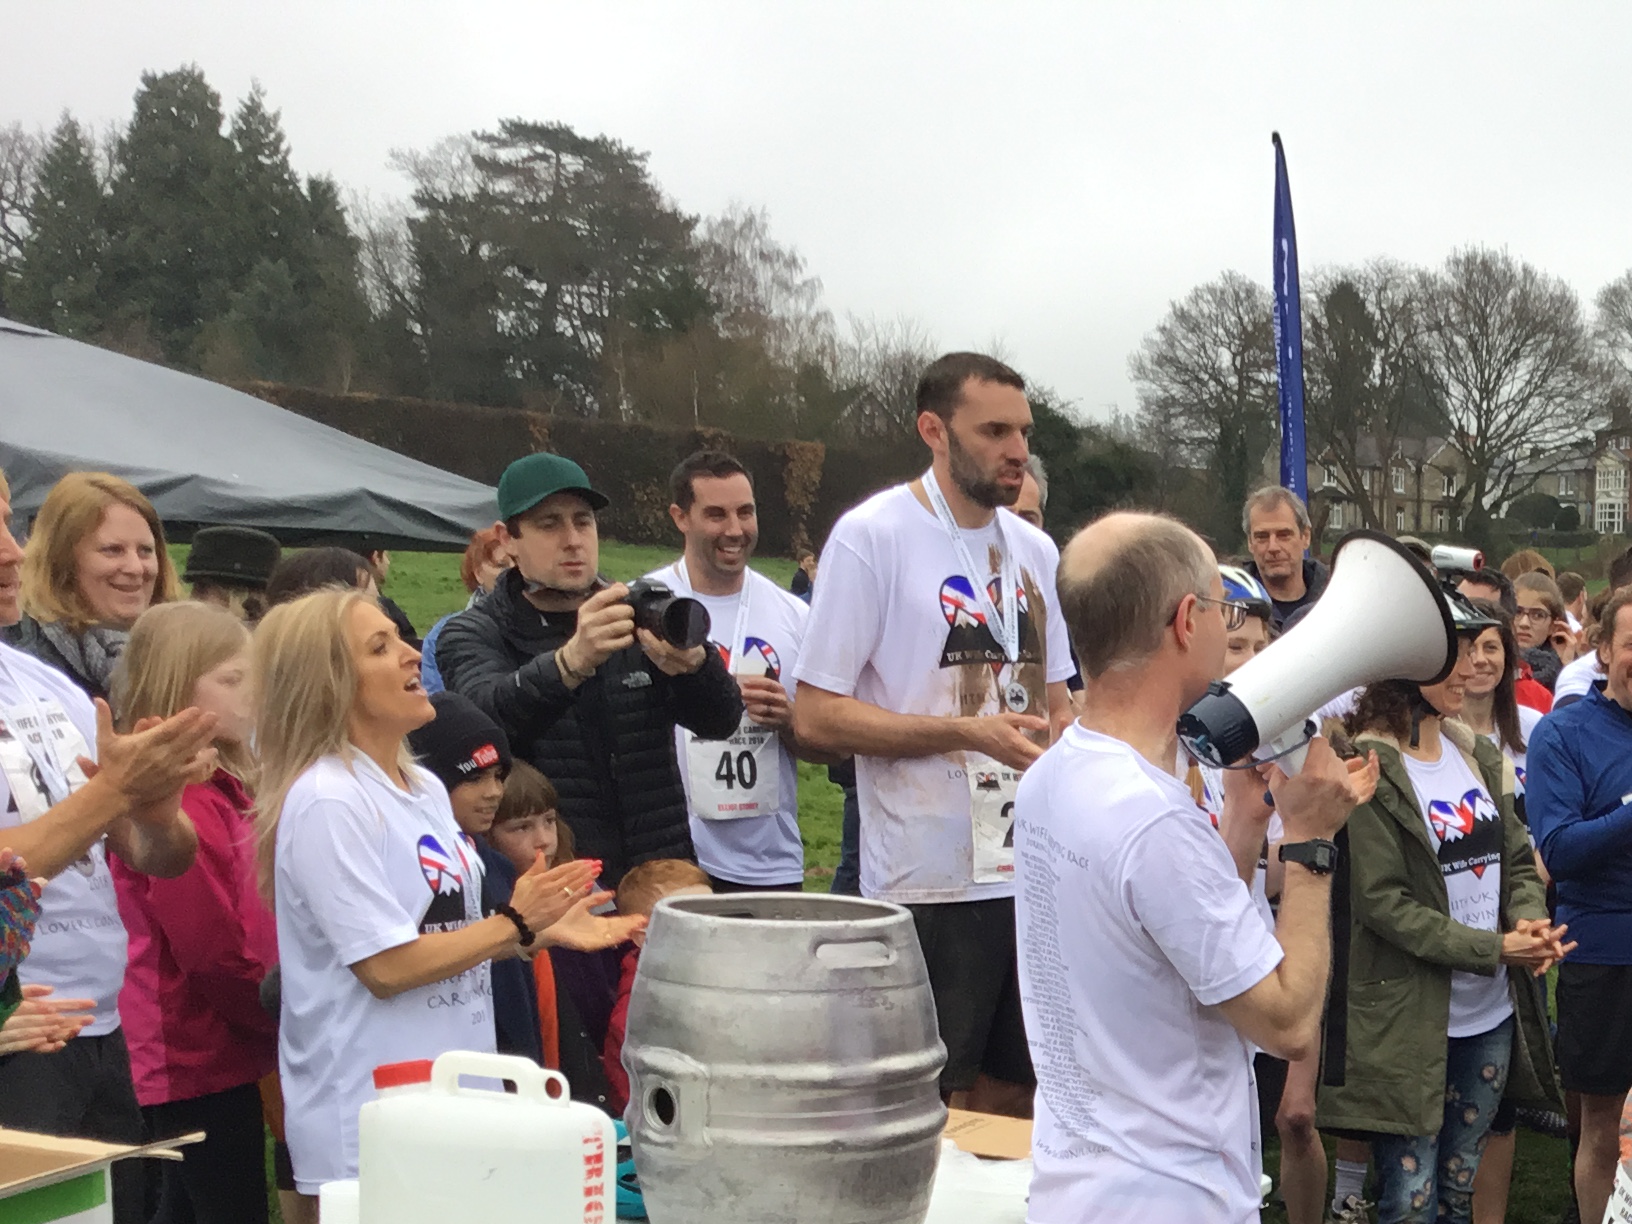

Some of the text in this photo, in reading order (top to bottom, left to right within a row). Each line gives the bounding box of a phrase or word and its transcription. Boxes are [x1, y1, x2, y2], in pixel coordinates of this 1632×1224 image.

[715, 749, 757, 790] 40
[947, 769, 968, 780] LOV
[1470, 891, 1494, 904] UK
